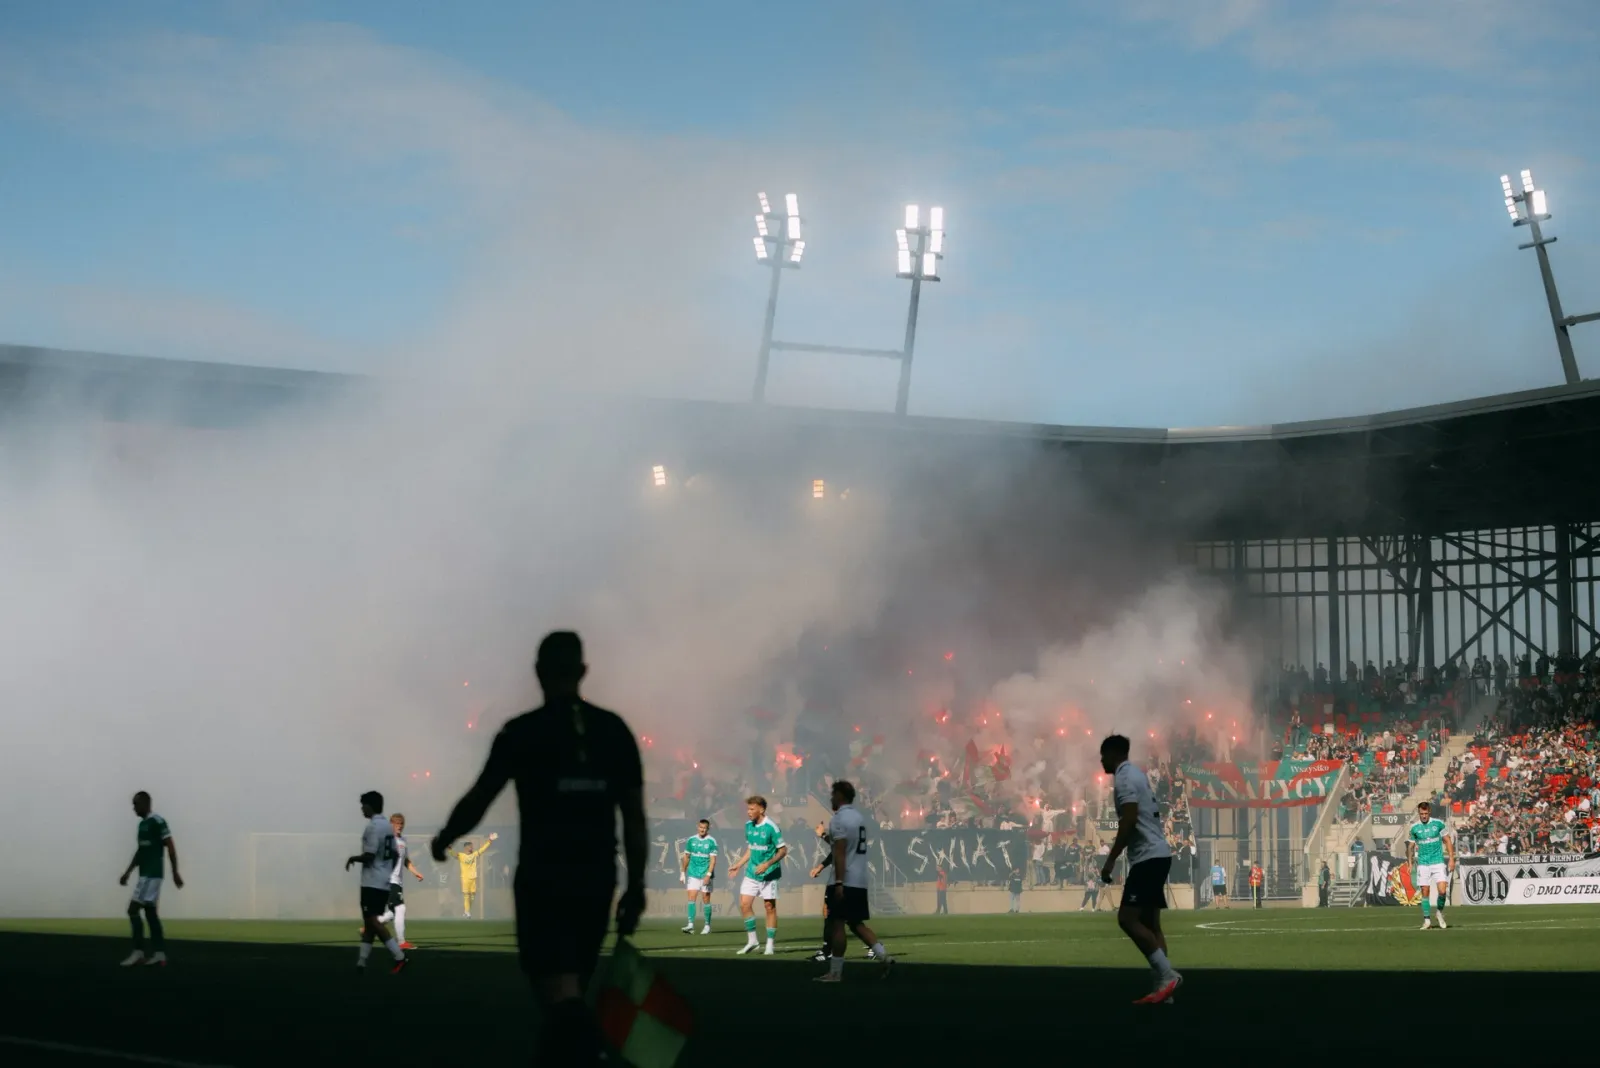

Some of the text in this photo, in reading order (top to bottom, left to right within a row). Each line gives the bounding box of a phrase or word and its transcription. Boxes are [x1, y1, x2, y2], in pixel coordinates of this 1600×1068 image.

[1186, 776, 1331, 801] FANATYCY
[1388, 815, 1398, 824] 09
[907, 830, 1013, 876] ŚWIAT
[1465, 866, 1509, 902] Old
[1537, 884, 1600, 895] DMD CATER
